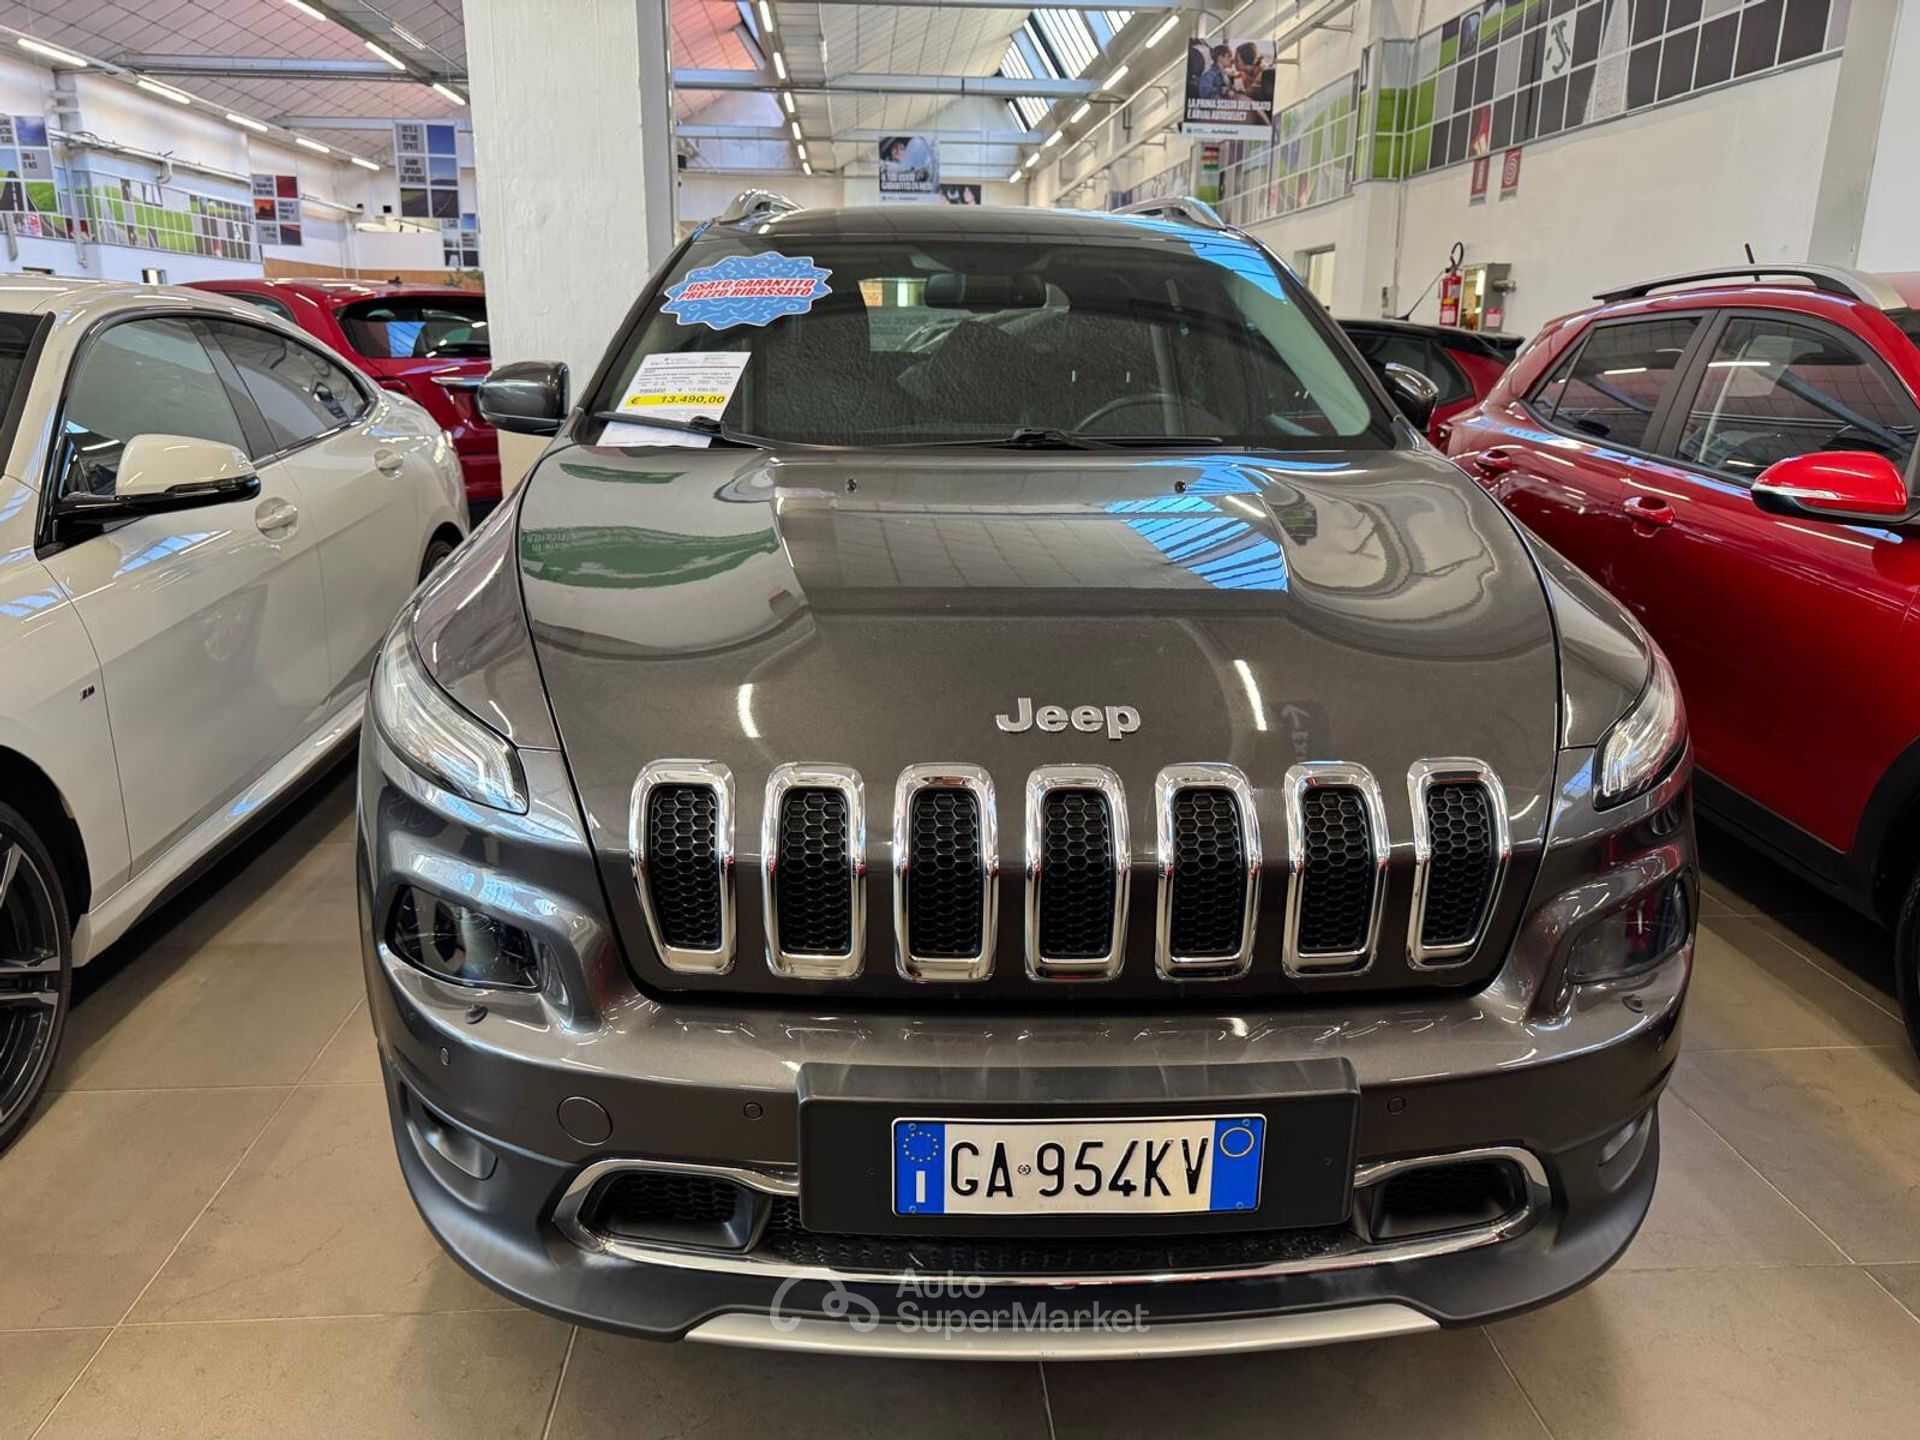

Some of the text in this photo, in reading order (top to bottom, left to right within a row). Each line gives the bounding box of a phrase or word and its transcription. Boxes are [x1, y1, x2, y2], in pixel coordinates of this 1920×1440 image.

[688, 278, 816, 292] USATO GARANTITO
[678, 287, 813, 300] PREZZO RIBASSATO
[660, 395, 725, 405] 13.490,00
[995, 697, 1141, 740] Jeep
[950, 1141, 1014, 1198] GA
[1035, 1137, 1209, 1197] 954KV
